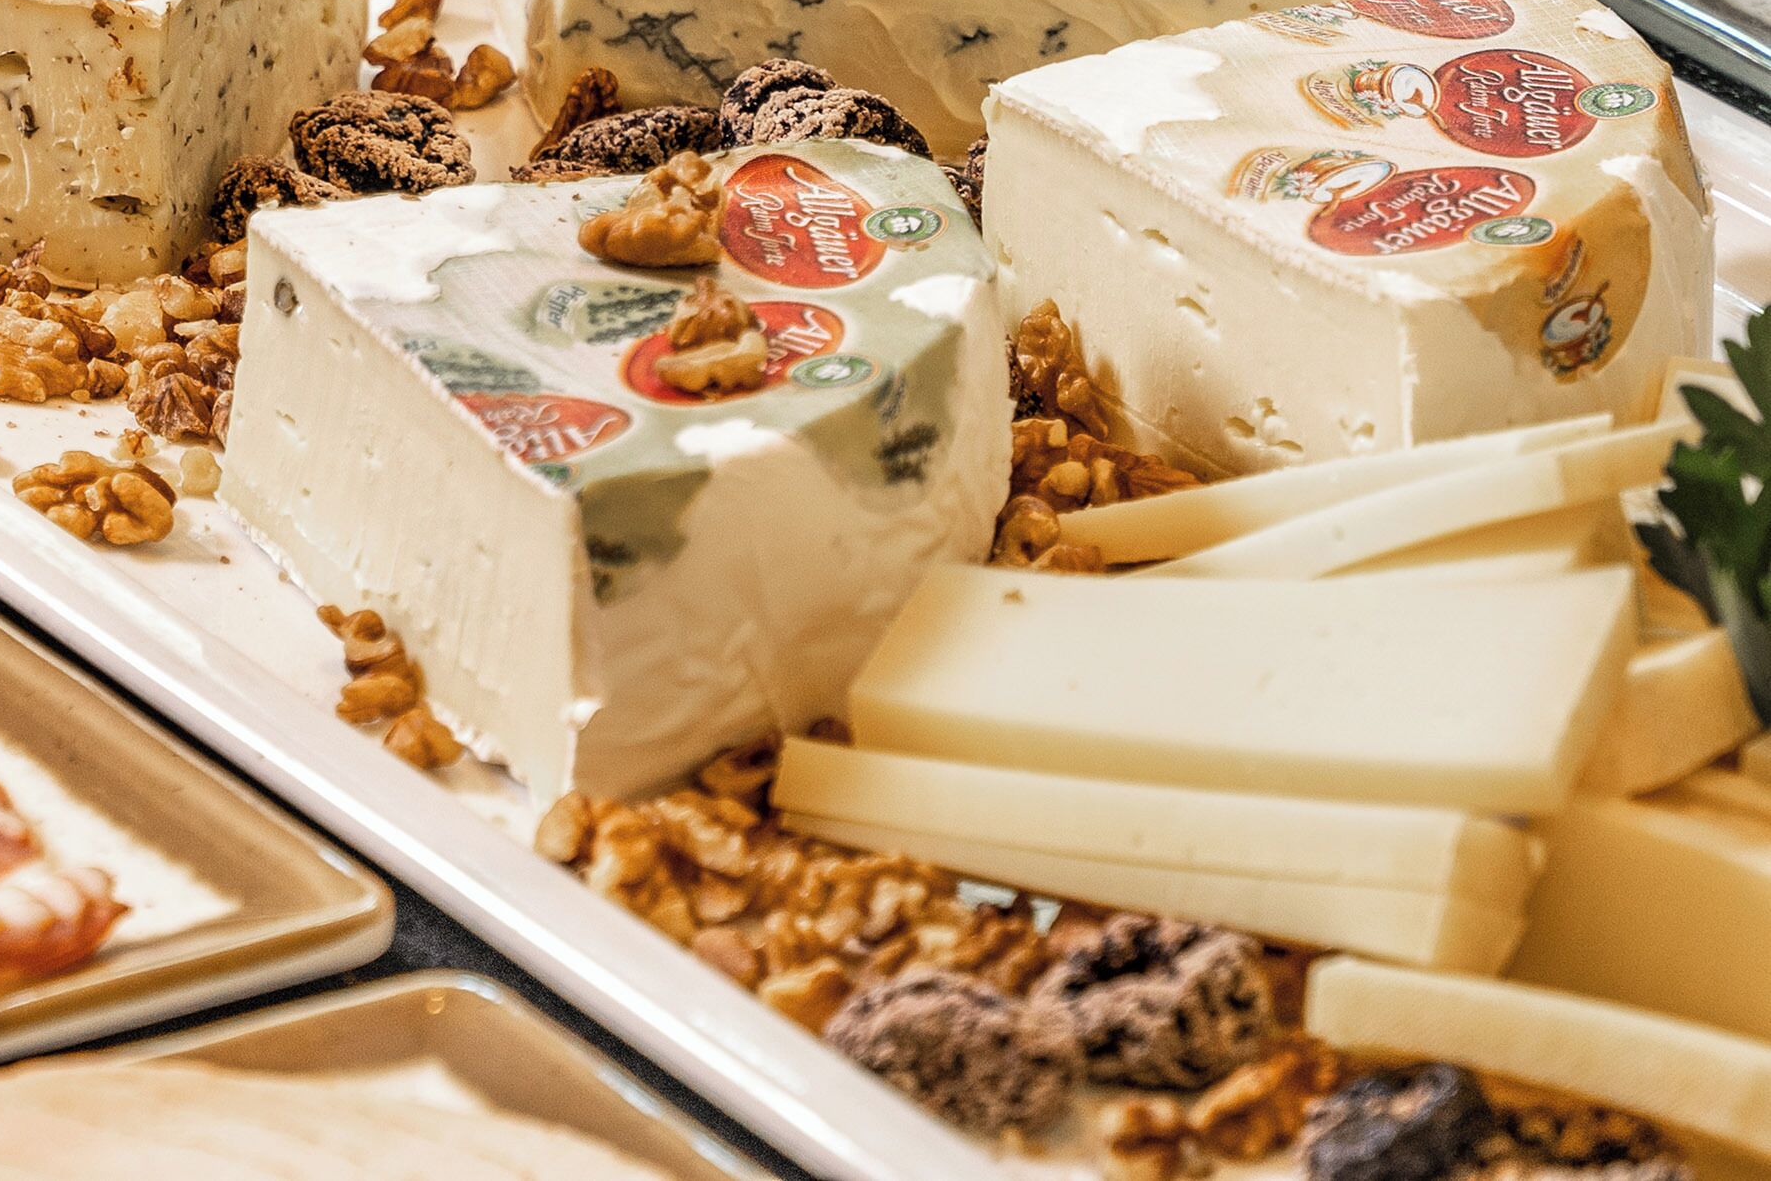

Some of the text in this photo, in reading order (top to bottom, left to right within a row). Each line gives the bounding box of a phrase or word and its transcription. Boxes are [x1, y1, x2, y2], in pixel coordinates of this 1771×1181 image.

[1457, 64, 1509, 139] Rahm Torte
[1502, 53, 1576, 150] Allgäuer
[734, 185, 798, 267] Rahm Torte
[784, 166, 859, 279] Allgäuer
[1341, 173, 1461, 233] Rahm Torte
[1372, 174, 1522, 255] Allgäuer
